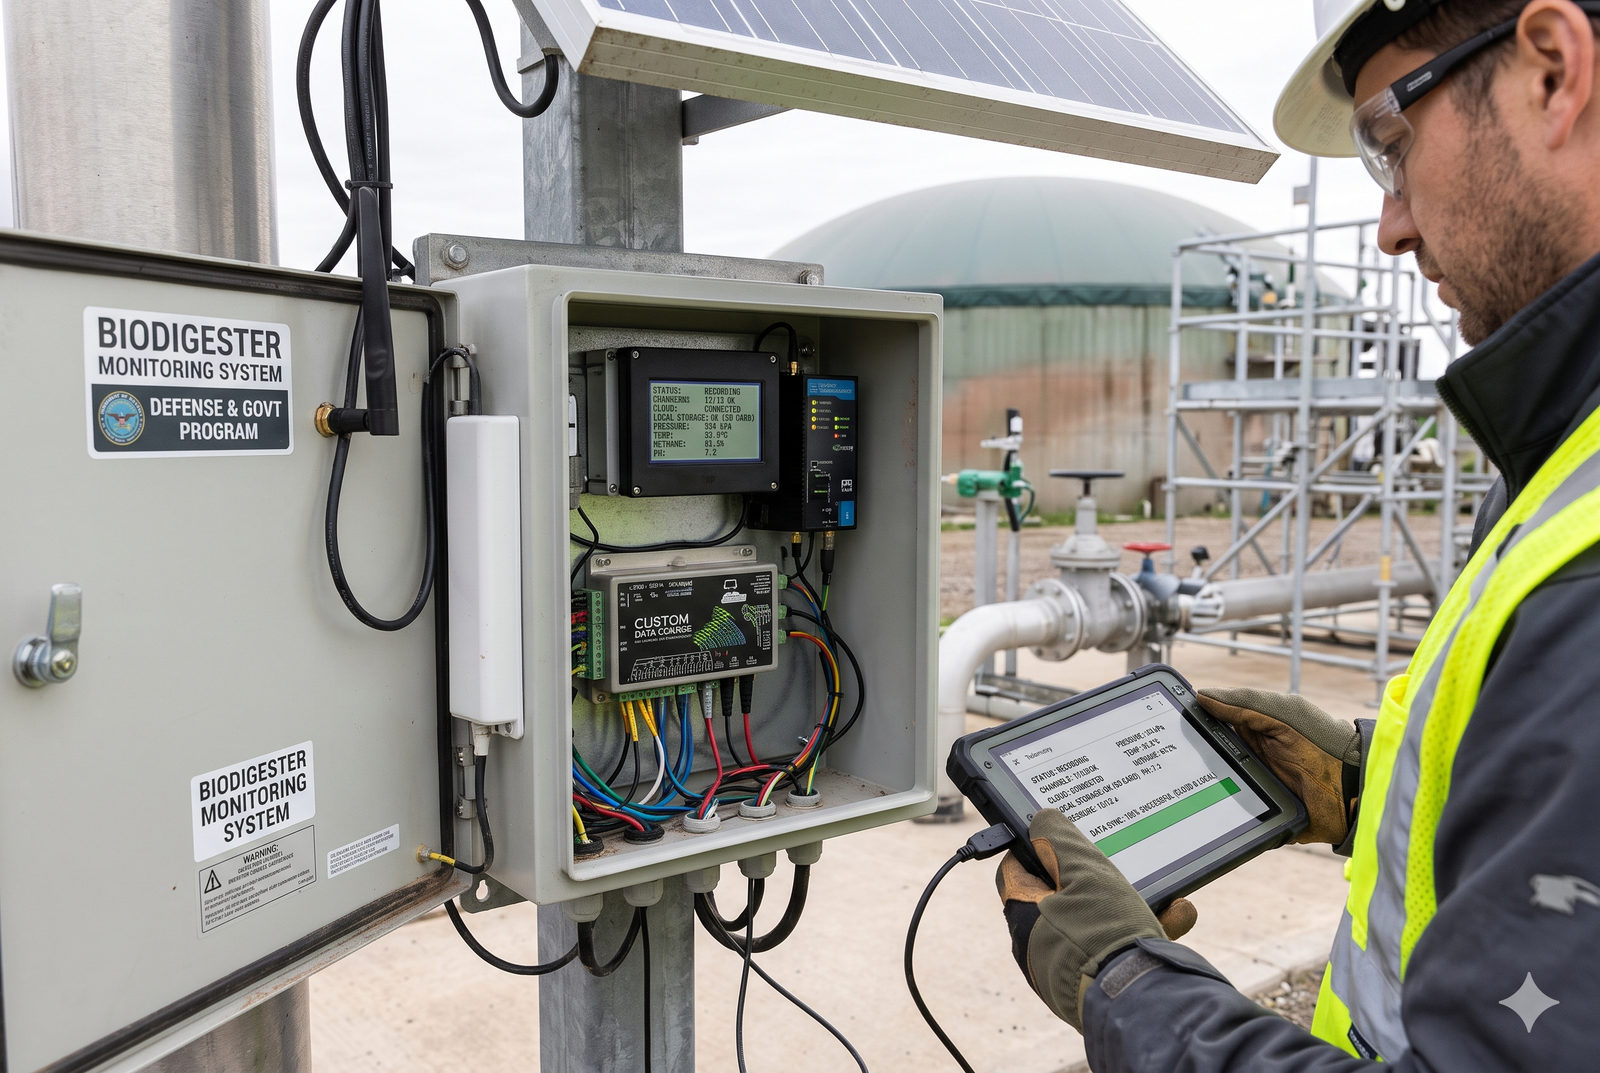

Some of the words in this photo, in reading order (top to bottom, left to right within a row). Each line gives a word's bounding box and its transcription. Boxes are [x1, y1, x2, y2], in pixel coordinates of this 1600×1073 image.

[98, 317, 282, 359] BIODIGESTER
[98, 356, 214, 379] MONITORING
[219, 362, 282, 382] SYSTEM
[653, 386, 681, 394] STATUS:
[150, 398, 224, 416] DEFENSE
[227, 400, 238, 417] &
[242, 400, 282, 418] GOVT
[653, 414, 674, 422] LOCAL
[677, 414, 708, 422] STORAGE:
[710, 414, 718, 422] OK
[653, 422, 690, 430] PRESSURE:
[180, 422, 258, 440] PROGRAM
[653, 440, 686, 448] METHANE:
[634, 613, 689, 630] CUSTOM
[634, 629, 656, 639] DATA
[200, 750, 306, 802] BIODIGESTER
[201, 772, 307, 827] MONITORING
[224, 802, 290, 843] SYSTEM
[243, 844, 279, 864] WARNING:
